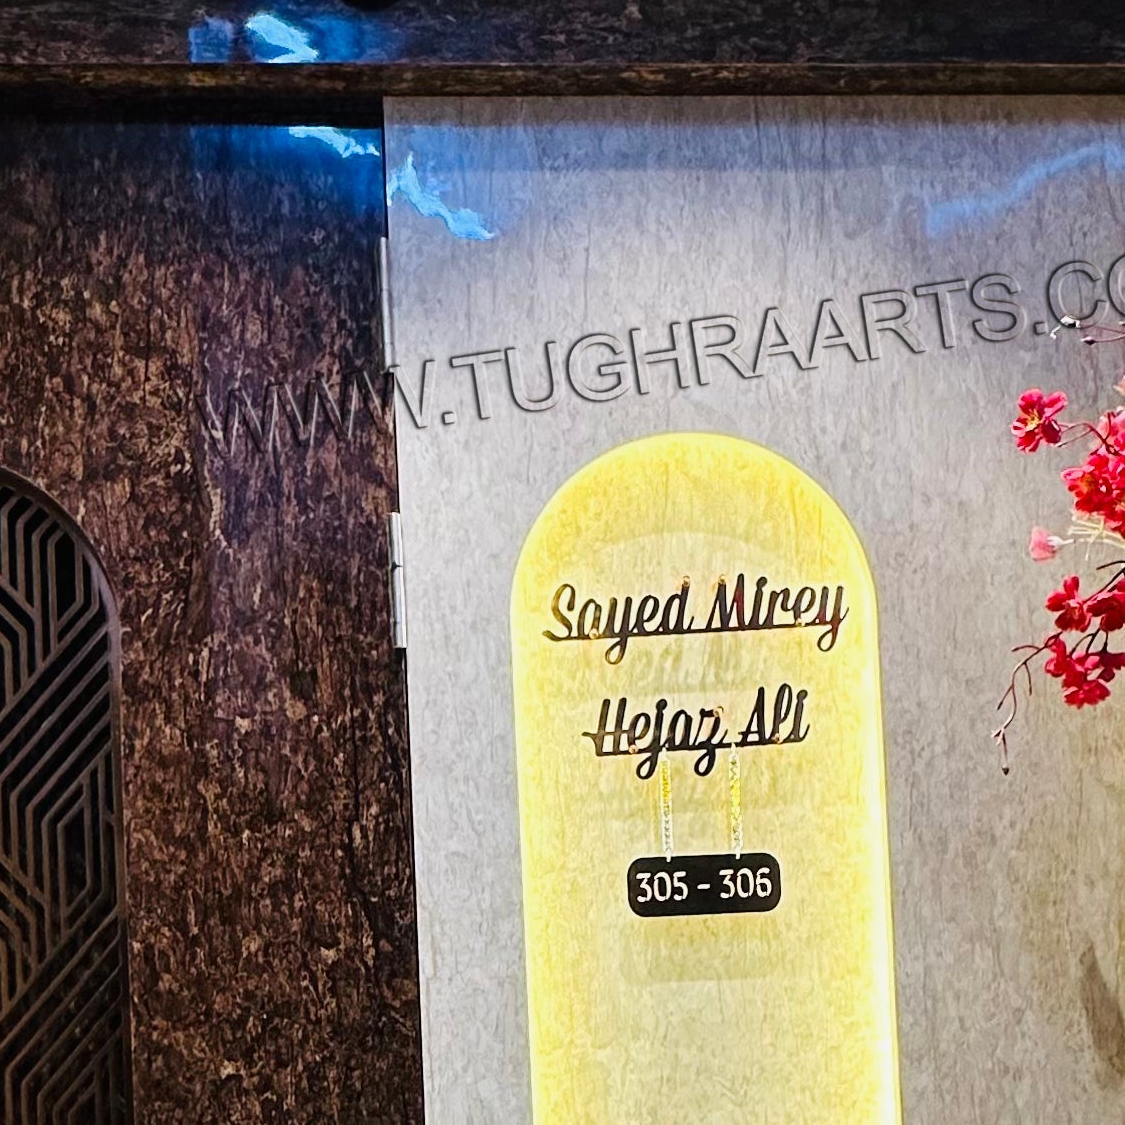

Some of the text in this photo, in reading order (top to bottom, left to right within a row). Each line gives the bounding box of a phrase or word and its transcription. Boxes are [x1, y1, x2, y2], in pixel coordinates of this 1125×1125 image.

[542, 573, 850, 665] Sayed Mirey
[581, 683, 812, 780] Hejaz Ali
[635, 870, 689, 903] 305
[718, 867, 773, 899] 306
